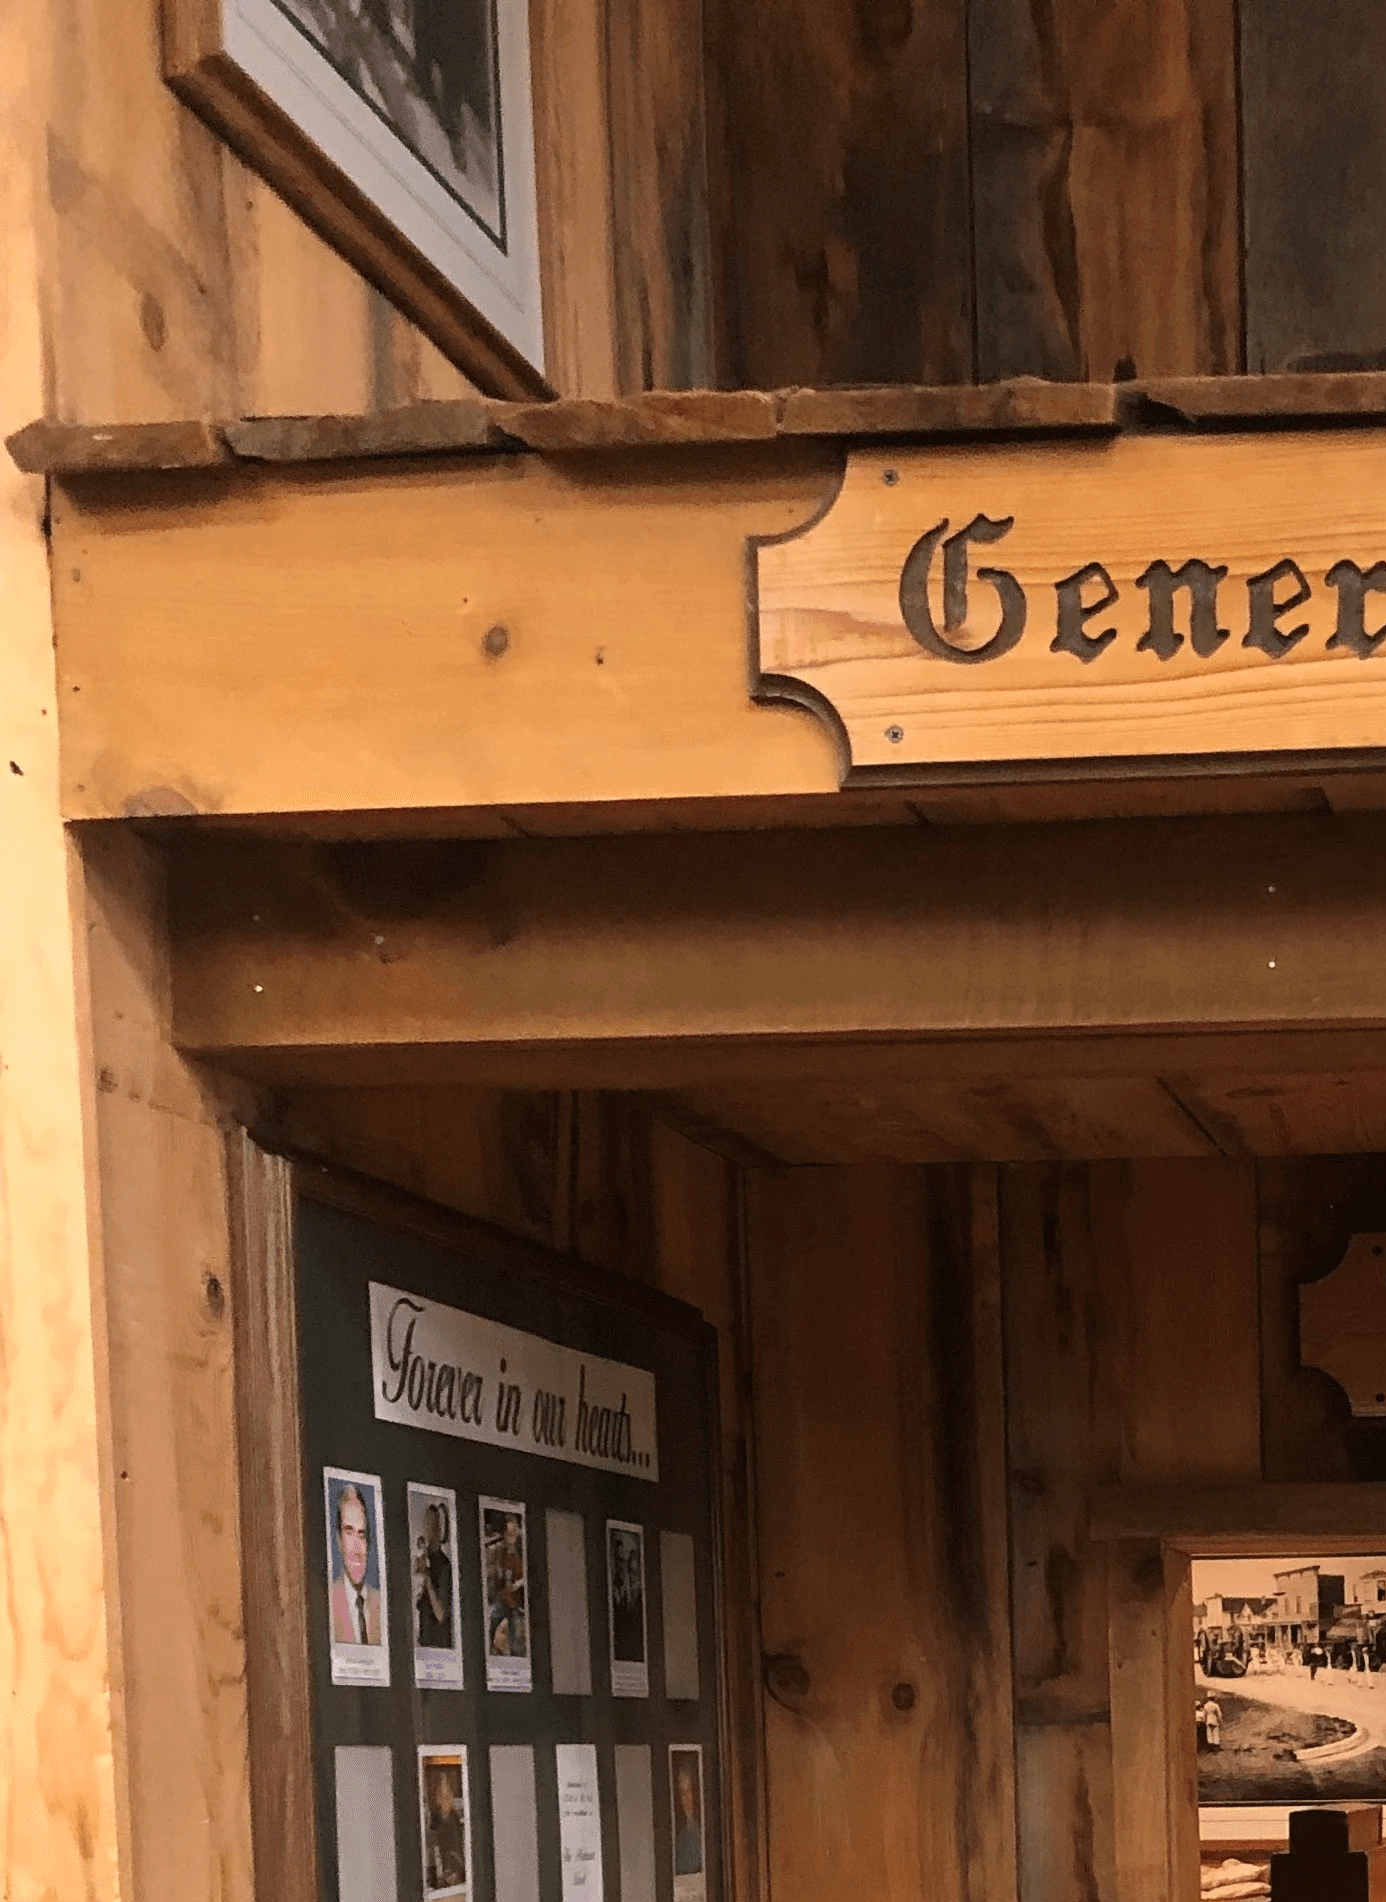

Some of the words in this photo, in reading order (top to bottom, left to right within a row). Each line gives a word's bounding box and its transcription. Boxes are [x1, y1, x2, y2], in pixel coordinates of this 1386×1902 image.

[381, 1296, 485, 1426] Forever
[495, 1357, 523, 1437] in
[531, 1386, 567, 1449] our
